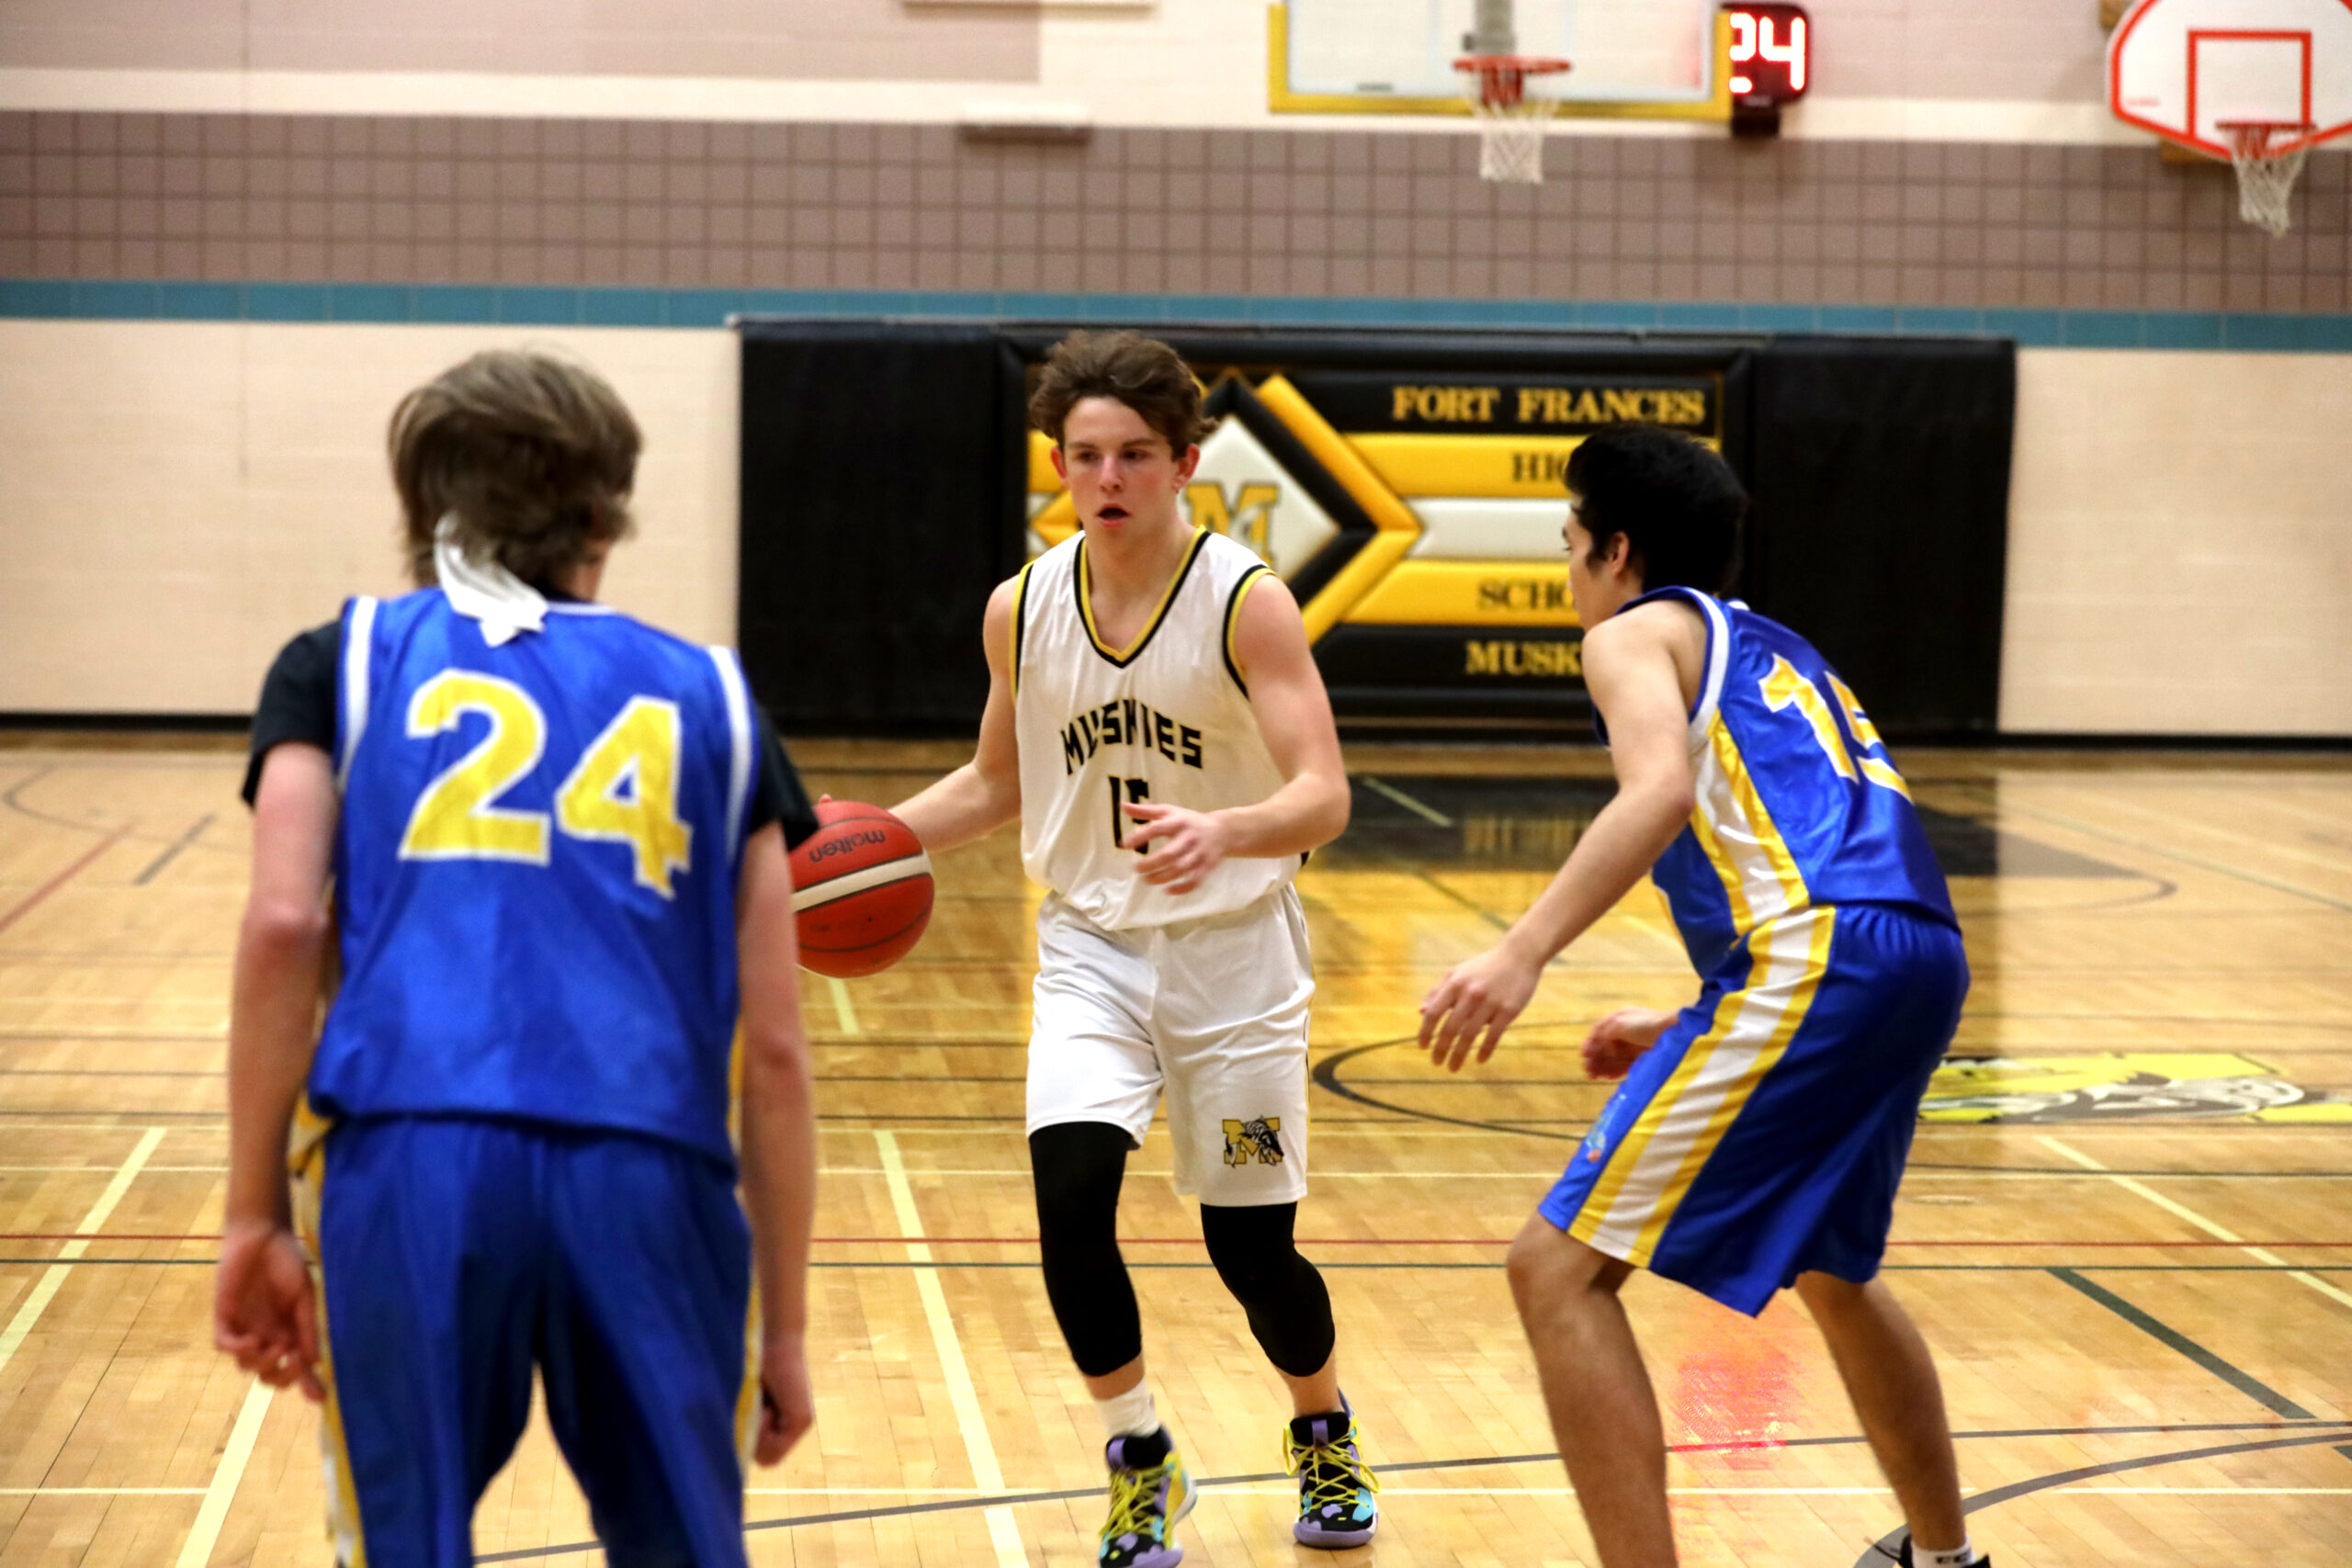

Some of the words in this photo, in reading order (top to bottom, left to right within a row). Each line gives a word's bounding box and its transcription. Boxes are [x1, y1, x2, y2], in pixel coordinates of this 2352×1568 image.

[1392, 385, 1500, 422] FORT
[1518, 389, 1705, 424] FRANCES
[1476, 578, 1573, 611] SCHO
[1465, 640, 1582, 675] MUSK
[1060, 698, 1204, 775] MUSKIES
[398, 668, 693, 901] 24
[808, 829, 887, 863] molten
